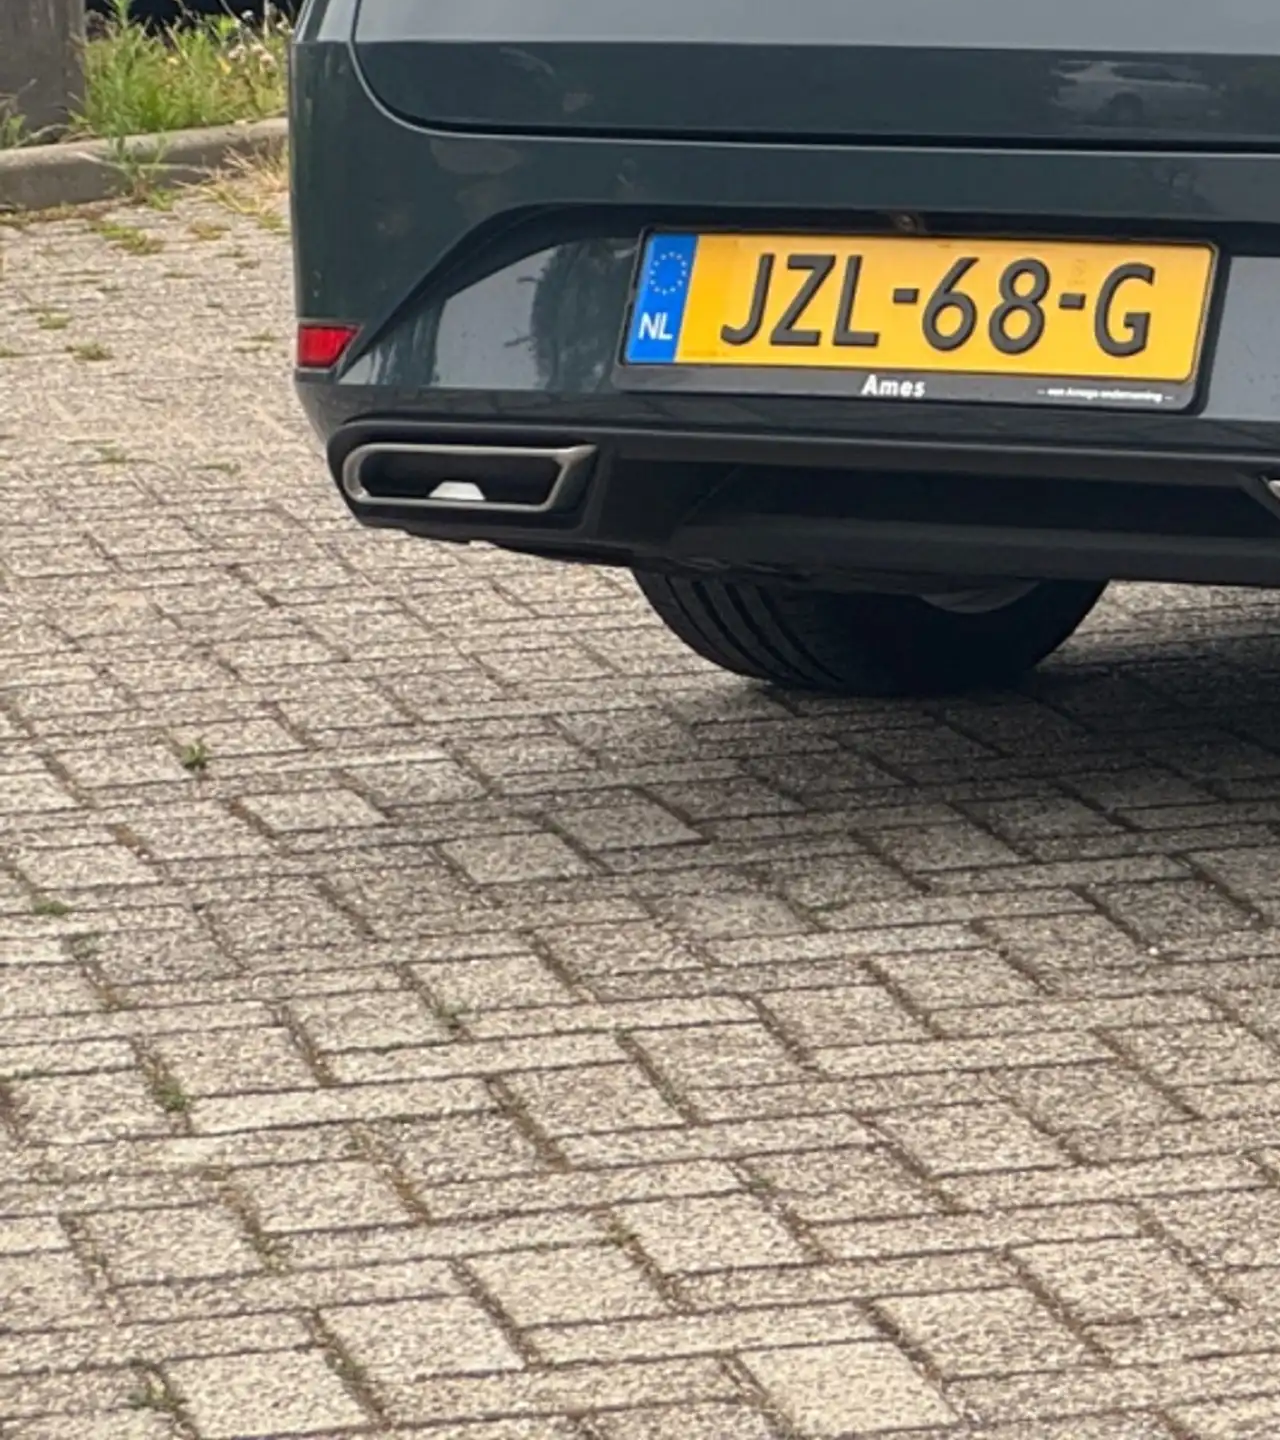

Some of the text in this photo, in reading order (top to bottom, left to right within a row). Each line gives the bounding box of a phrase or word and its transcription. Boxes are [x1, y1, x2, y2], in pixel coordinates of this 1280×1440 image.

[720, 253, 1155, 358] JZL-68-G
[638, 312, 673, 340] NL
[861, 374, 926, 398] Ames
